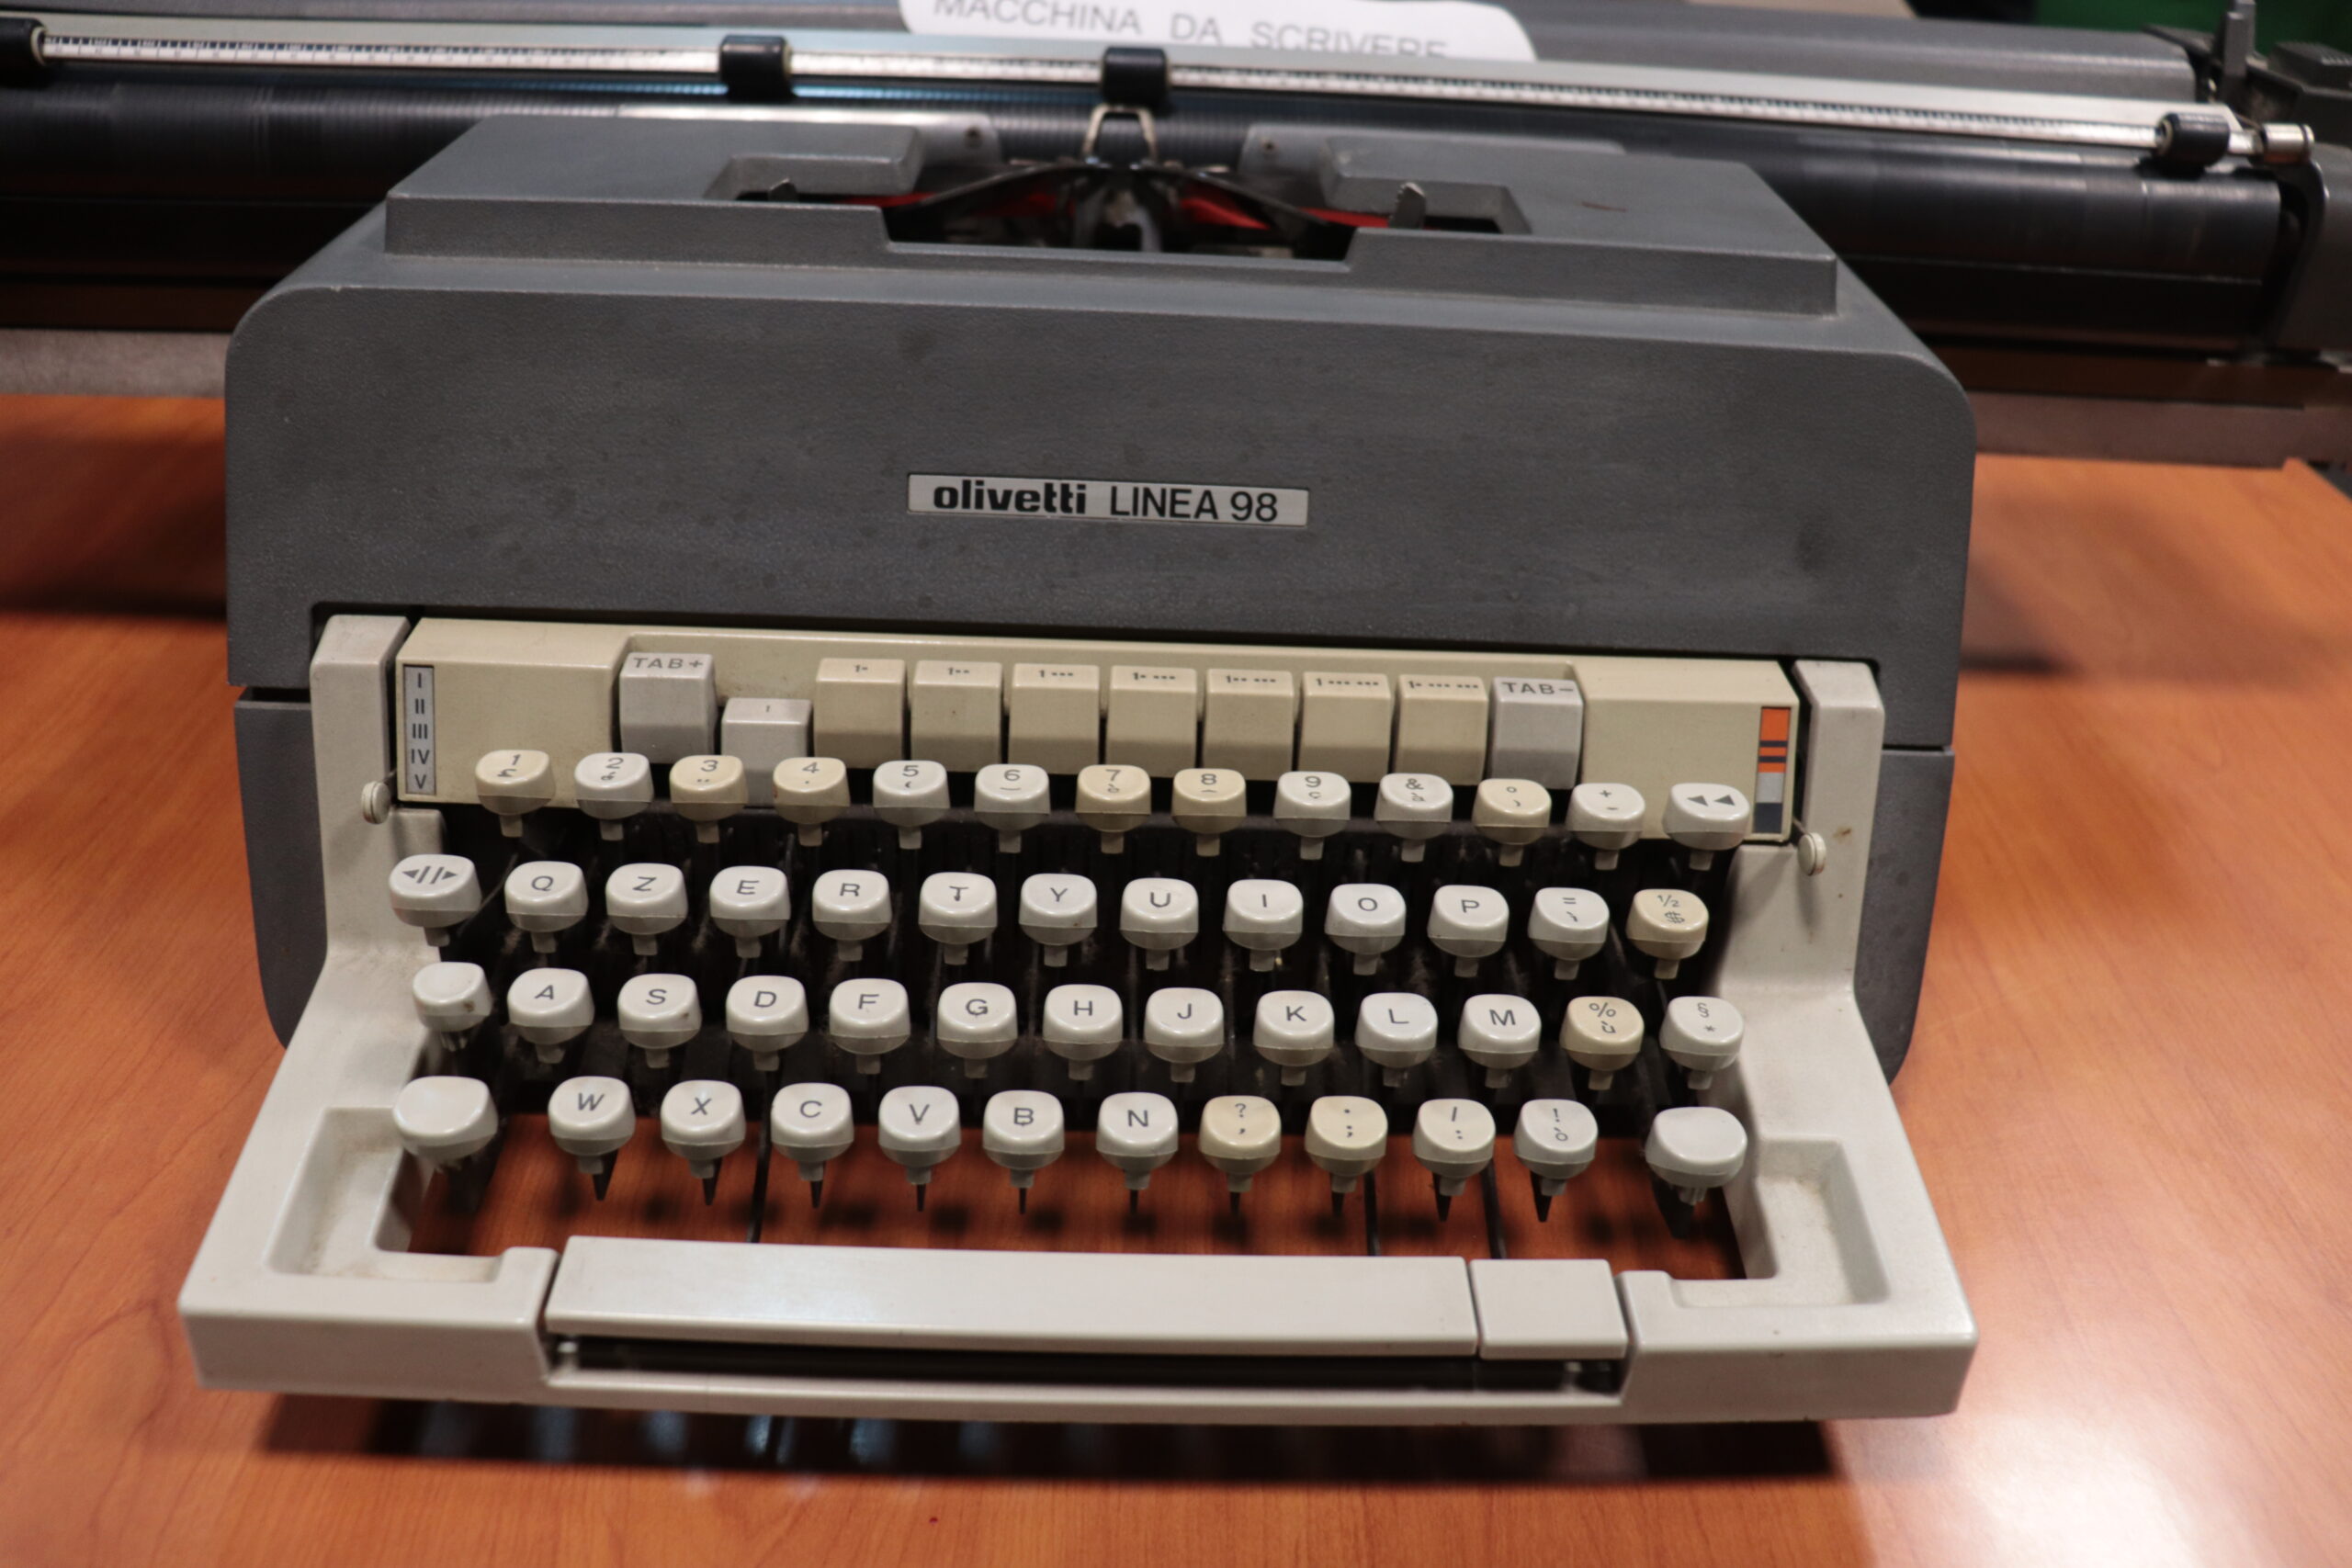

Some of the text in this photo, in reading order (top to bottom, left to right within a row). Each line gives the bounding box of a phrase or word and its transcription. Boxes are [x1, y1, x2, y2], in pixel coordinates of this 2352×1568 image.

[933, 0, 1144, 35] MACCHINA
[1169, 12, 1224, 45] DA
[933, 479, 1278, 523] olivetti LINEA 98
[414, 698, 425, 715] II
[412, 723, 428, 739] III
[411, 749, 430, 765] IV
[605, 757, 625, 770] 2
[701, 759, 718, 773] 3
[802, 761, 820, 774] 4
[902, 764, 920, 777] 5
[414, 773, 427, 790] V
[1003, 769, 1021, 782] 6
[1105, 768, 1122, 782] 7
[1201, 773, 1217, 785] 8
[1305, 775, 1322, 788] 9
[1405, 777, 1424, 790] &
[531, 875, 554, 892] Q
[632, 876, 657, 892] Z
[736, 879, 760, 896] E
[839, 882, 861, 897] R
[949, 886, 969, 901] T
[1050, 887, 1068, 903] Y
[1149, 892, 1171, 908] U
[1357, 897, 1378, 912] O
[1461, 899, 1480, 913] P
[1664, 911, 1686, 925] $
[534, 984, 555, 1000] A
[646, 988, 667, 1006] S
[753, 990, 777, 1009] D
[857, 993, 879, 1010] F
[965, 998, 989, 1017] G
[1073, 1000, 1093, 1017] H
[1589, 1001, 1617, 1018] %
[1177, 1003, 1193, 1020] J
[1285, 1006, 1306, 1022] K
[1388, 1009, 1409, 1024] L
[1489, 1009, 1516, 1026] M
[578, 1092, 605, 1111] W
[691, 1097, 712, 1116] X
[799, 1100, 822, 1119] C
[909, 1103, 930, 1125] V
[1013, 1107, 1035, 1127] B
[1234, 1102, 1247, 1118] ?
[1127, 1109, 1149, 1128] N
